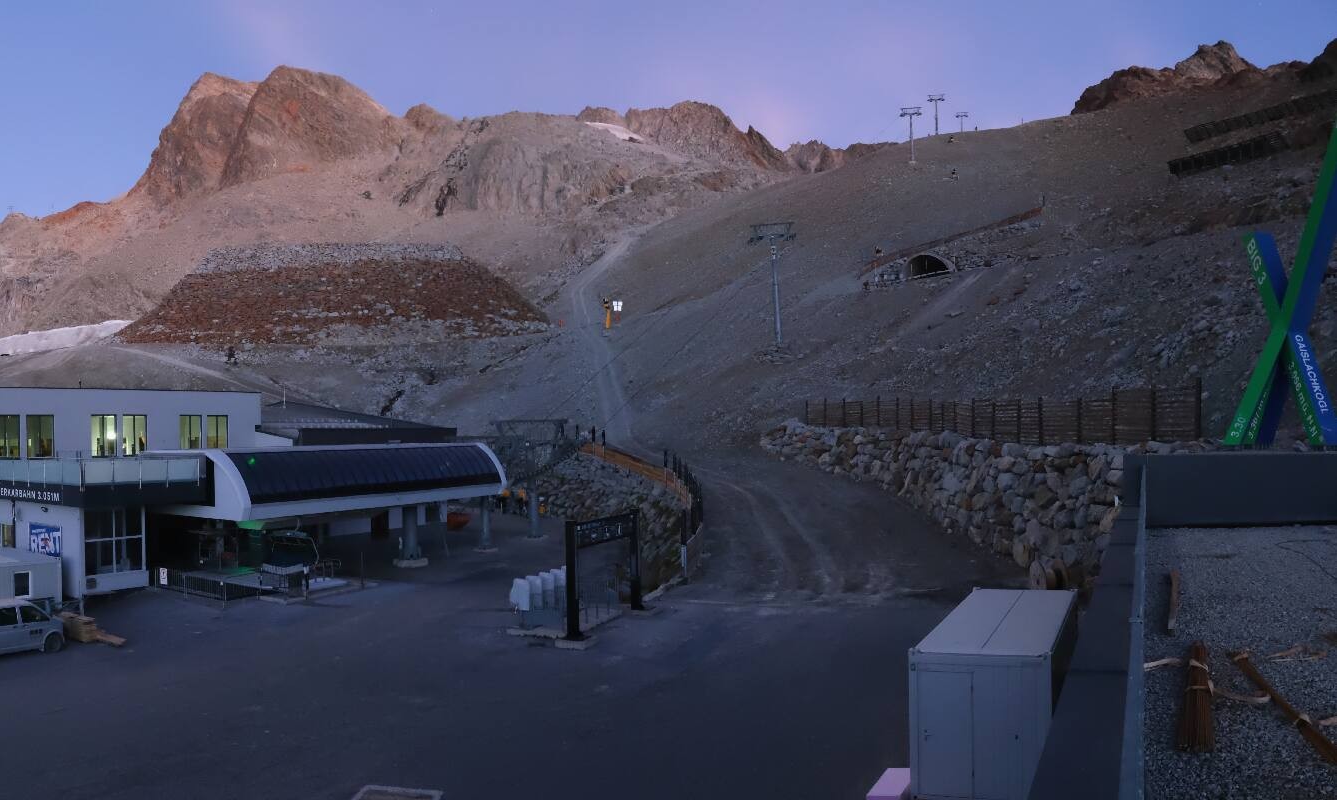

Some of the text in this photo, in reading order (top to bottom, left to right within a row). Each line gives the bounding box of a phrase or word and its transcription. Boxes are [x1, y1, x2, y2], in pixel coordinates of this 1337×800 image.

[1247, 238, 1267, 285] BIG 3
[1294, 334, 1329, 414] GAISLACHKOGL
[30, 531, 61, 555] RENT
